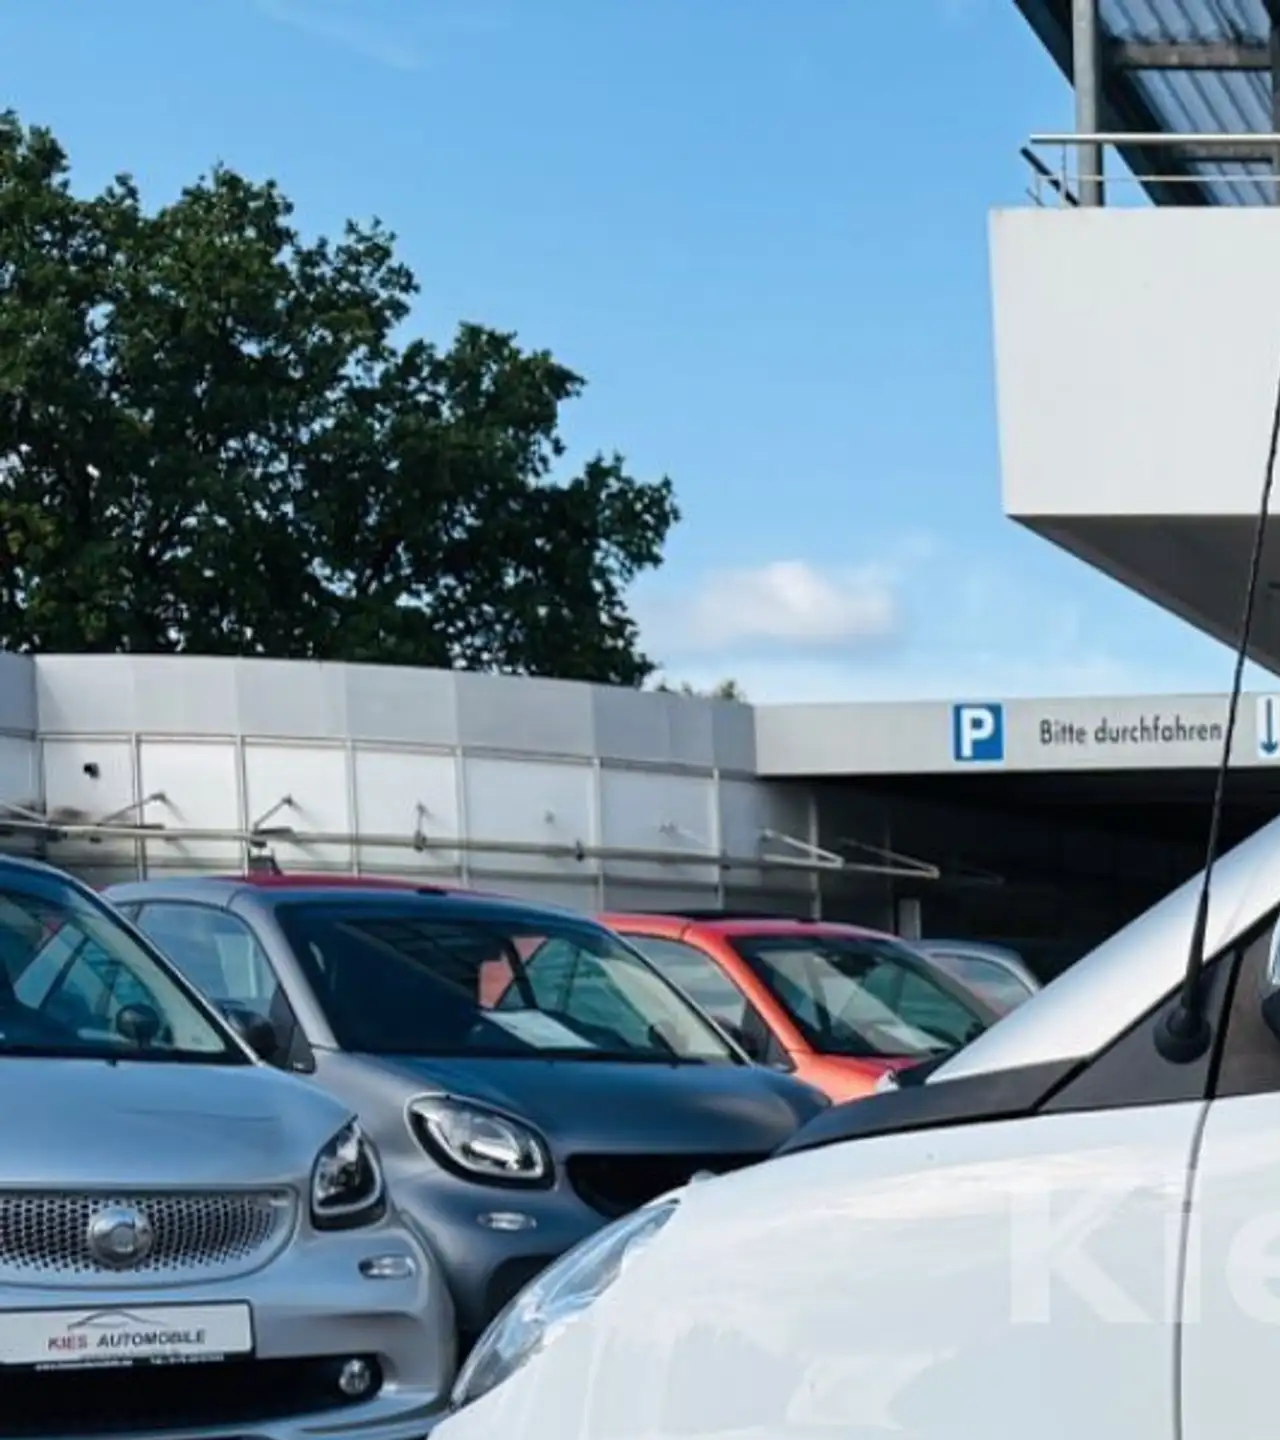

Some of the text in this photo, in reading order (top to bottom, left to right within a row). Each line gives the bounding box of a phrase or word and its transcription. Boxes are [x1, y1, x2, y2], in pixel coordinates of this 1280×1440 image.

[960, 707, 995, 758] P
[1039, 714, 1222, 745] Bitte durchfahren
[48, 1328, 207, 1350] KIES AUTOMOBILE
